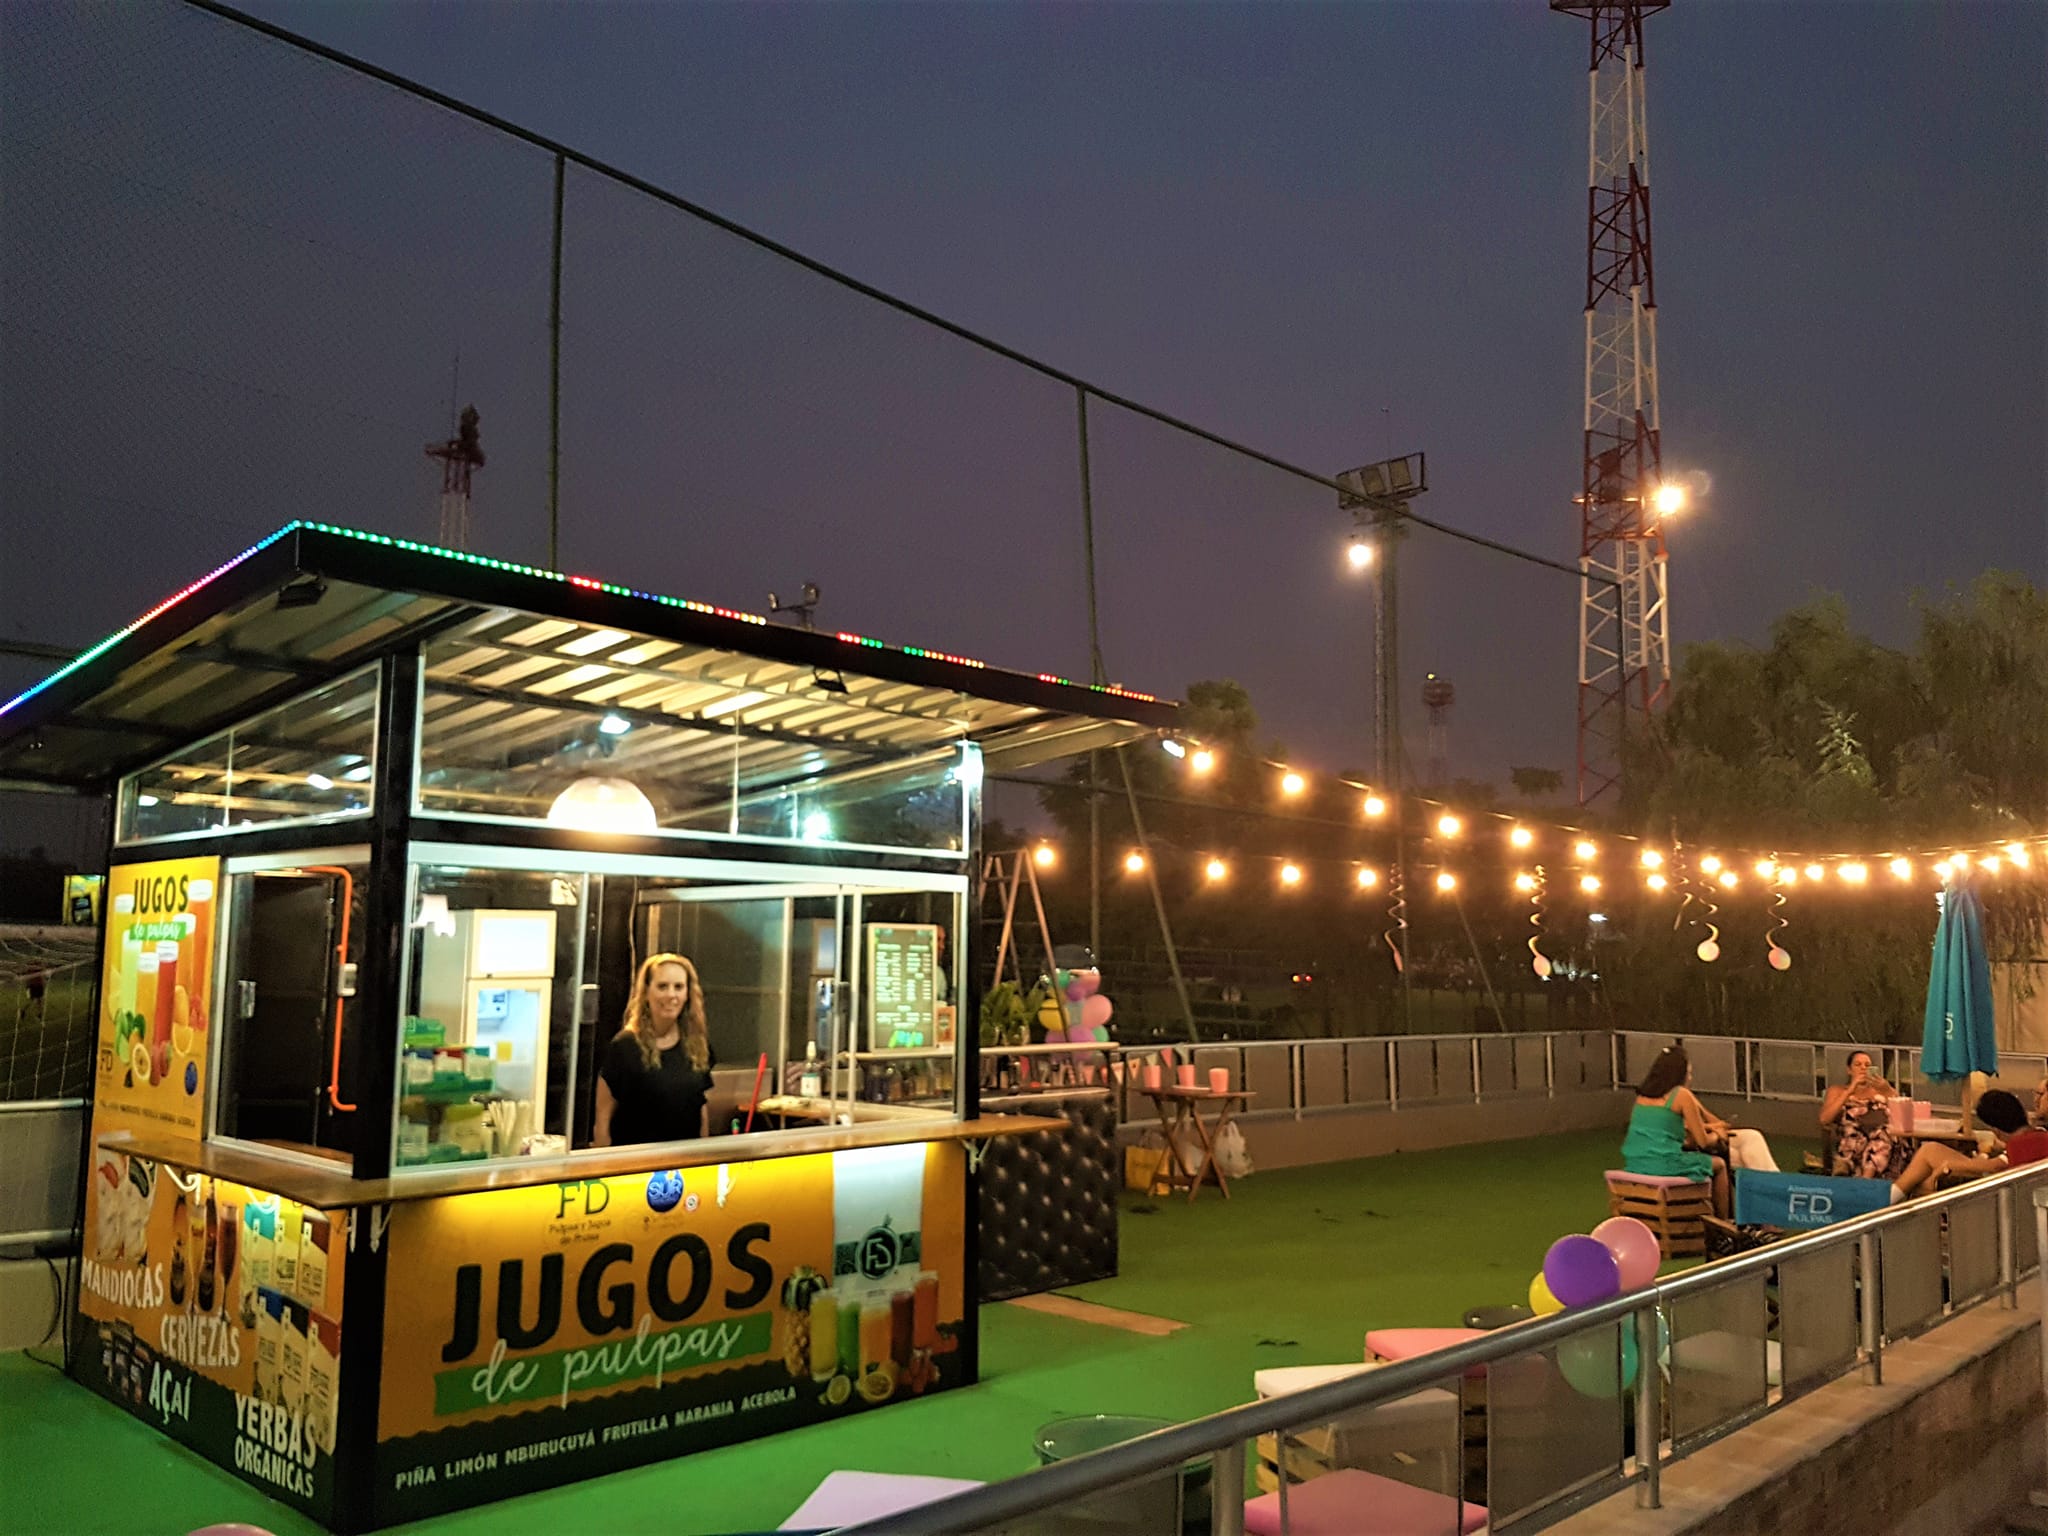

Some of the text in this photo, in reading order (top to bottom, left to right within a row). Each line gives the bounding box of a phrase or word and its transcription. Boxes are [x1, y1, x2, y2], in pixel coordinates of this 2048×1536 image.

[131, 874, 189, 915] JUGOS
[555, 1178, 610, 1219] FD
[1789, 1193, 1833, 1215] FD
[81, 1257, 164, 1309] MANDIOCAS
[441, 1222, 774, 1363] JUGOS
[160, 1312, 241, 1368] CERVEZAS
[471, 1313, 744, 1411] de pulpas
[235, 1391, 317, 1470] YERBAS
[395, 1465, 437, 1490] PIÑA
[445, 1450, 498, 1479] LIMÓN
[602, 1414, 669, 1443] FRUTILLA
[741, 1385, 797, 1412] ACEROLA
[234, 1434, 314, 1499] ORGANICAS
